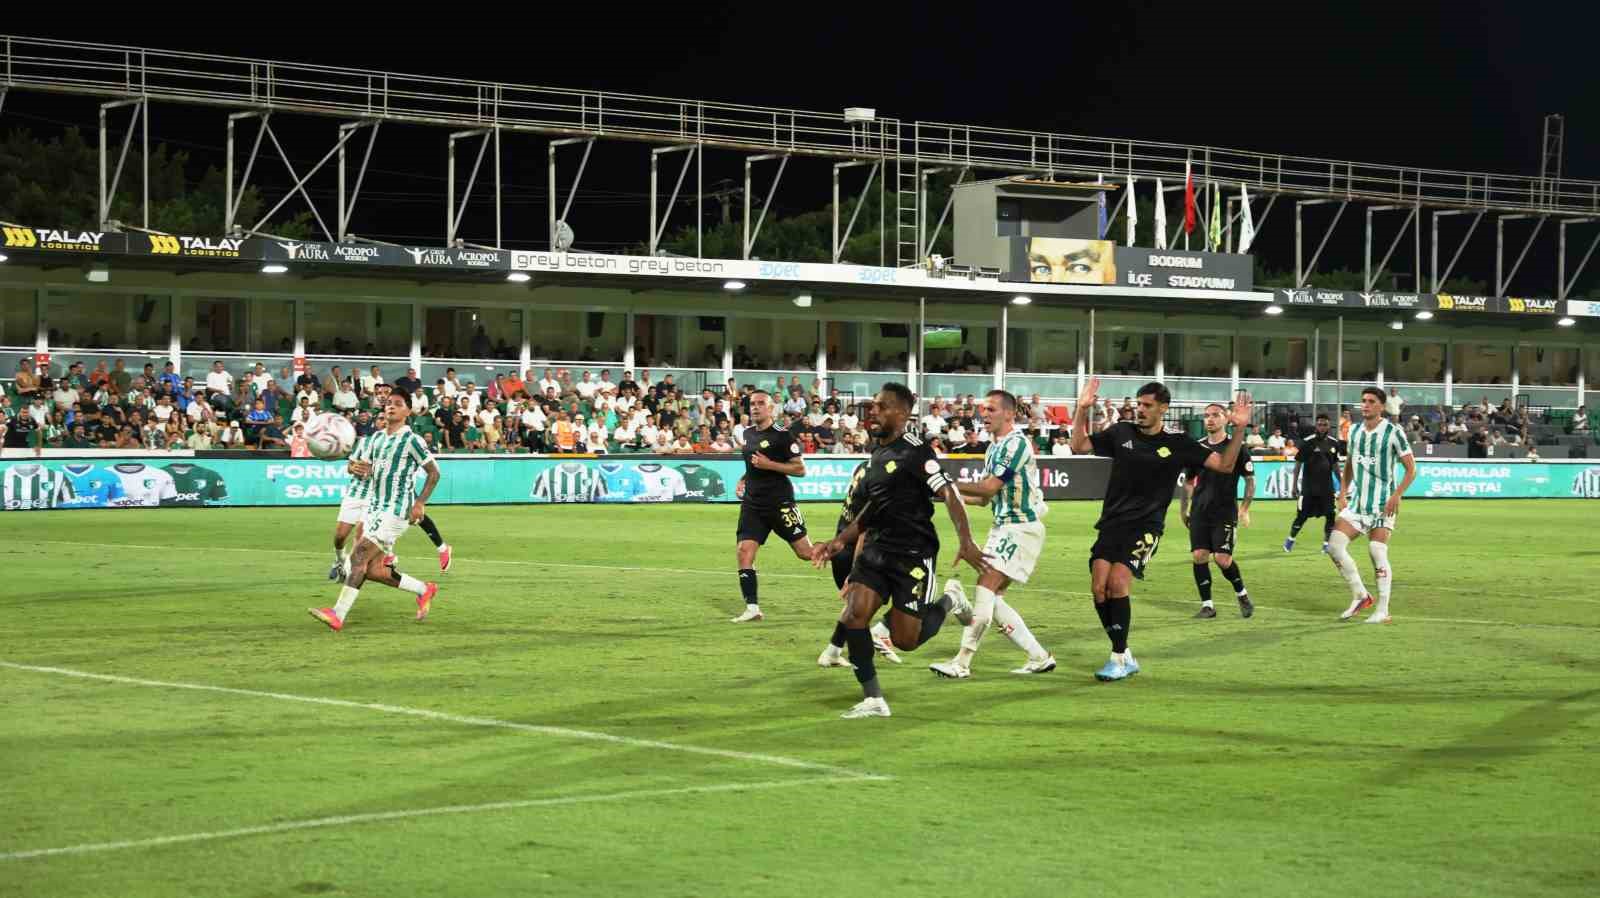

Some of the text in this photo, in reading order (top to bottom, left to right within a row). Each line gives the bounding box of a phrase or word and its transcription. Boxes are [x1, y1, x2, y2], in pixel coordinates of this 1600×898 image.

[36, 229, 104, 244] TALAY
[40, 242, 100, 251] LOGISTICS
[180, 236, 243, 251] TALAY
[184, 249, 240, 258] LOGISTICS
[298, 248, 329, 260] AURA
[334, 246, 380, 257] ACROPOL
[457, 250, 500, 262] ACROPOL
[423, 253, 452, 265] AURA
[517, 253, 617, 269] grey beton
[628, 257, 724, 273] grey beton
[1148, 254, 1203, 268] BODRUM
[1127, 270, 1235, 290] İLÇE STADYUMU
[1452, 295, 1487, 306] TALAY
[1524, 298, 1558, 309] TALAY
[266, 464, 350, 479] FORM
[1420, 466, 1511, 478] FORMALAR
[175, 491, 201, 502] pet
[285, 484, 347, 498] SATI
[782, 512, 797, 527] 39
[995, 537, 1018, 560] 34
